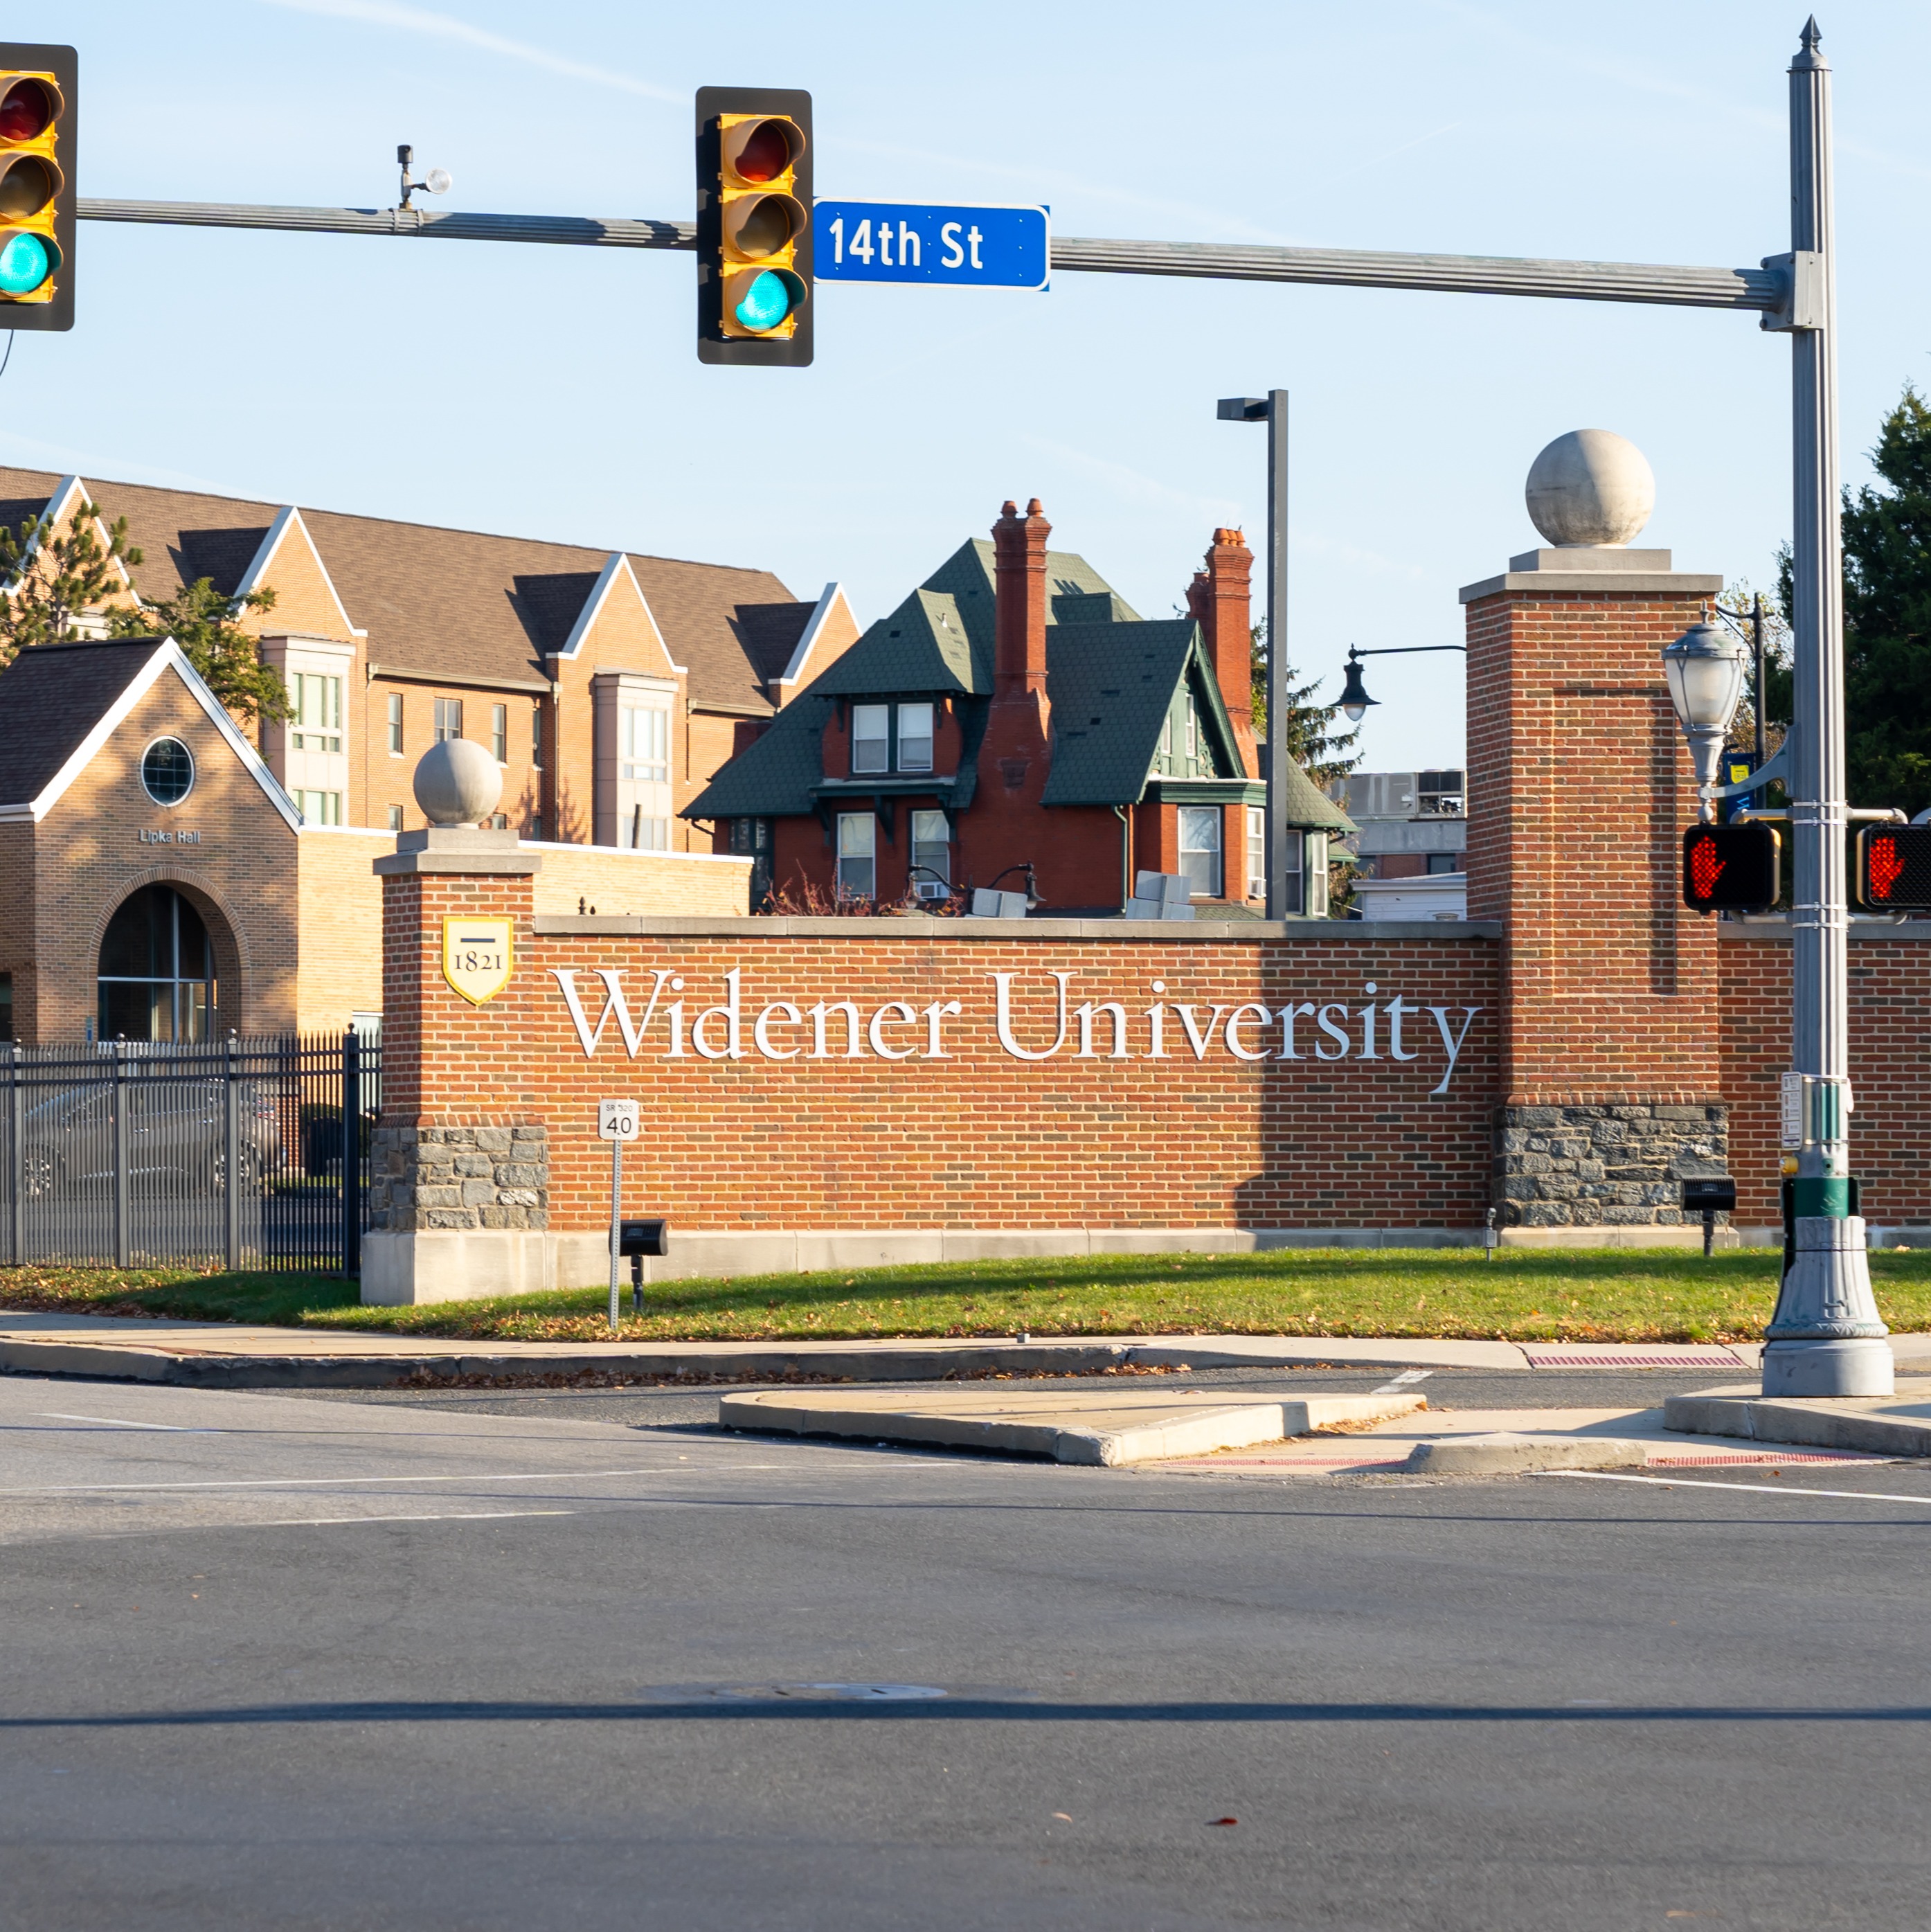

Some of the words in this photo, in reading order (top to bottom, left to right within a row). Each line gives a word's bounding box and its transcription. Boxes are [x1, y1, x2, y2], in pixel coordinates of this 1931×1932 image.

[829, 217, 921, 267] 14th
[940, 222, 983, 269] St
[139, 829, 172, 846] Lipka
[177, 830, 200, 844] Hall
[454, 951, 502, 972] 1821
[551, 967, 962, 1059] Widener
[985, 971, 1484, 1093] University
[607, 1117, 631, 1134] 40
